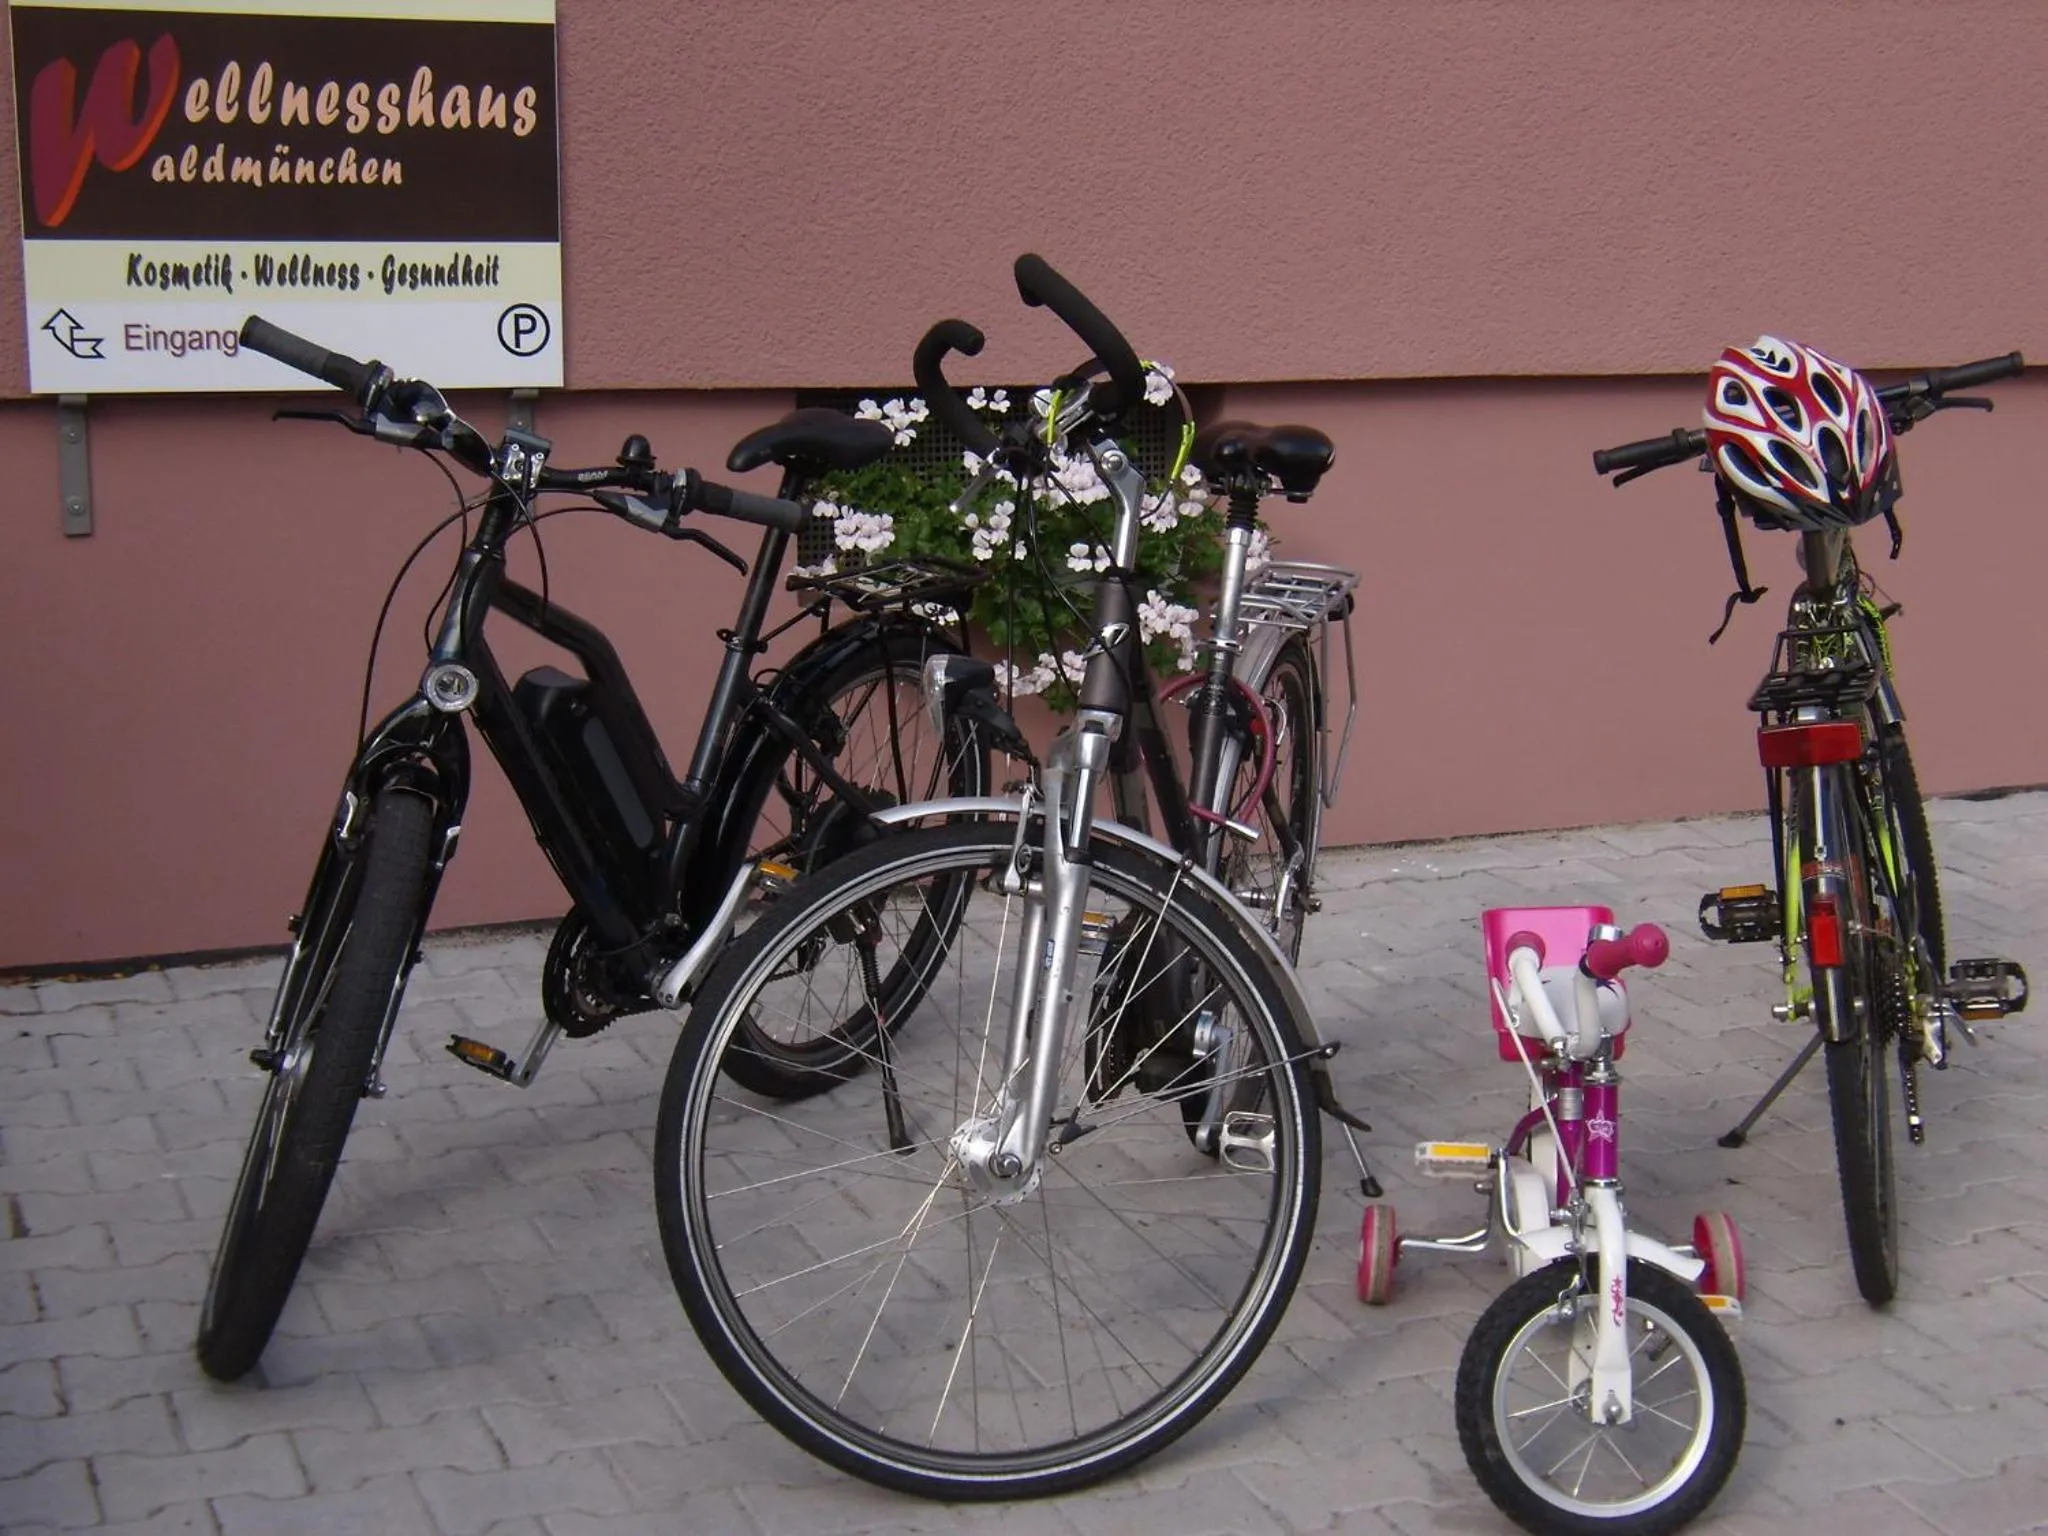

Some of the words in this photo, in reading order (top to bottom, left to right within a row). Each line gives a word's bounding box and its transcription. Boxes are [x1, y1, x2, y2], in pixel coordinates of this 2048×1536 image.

[126, 252, 233, 294] Kosmetik
[254, 253, 361, 291] Wellness
[381, 251, 500, 295] Gesundheit
[123, 323, 240, 358] Eingang
